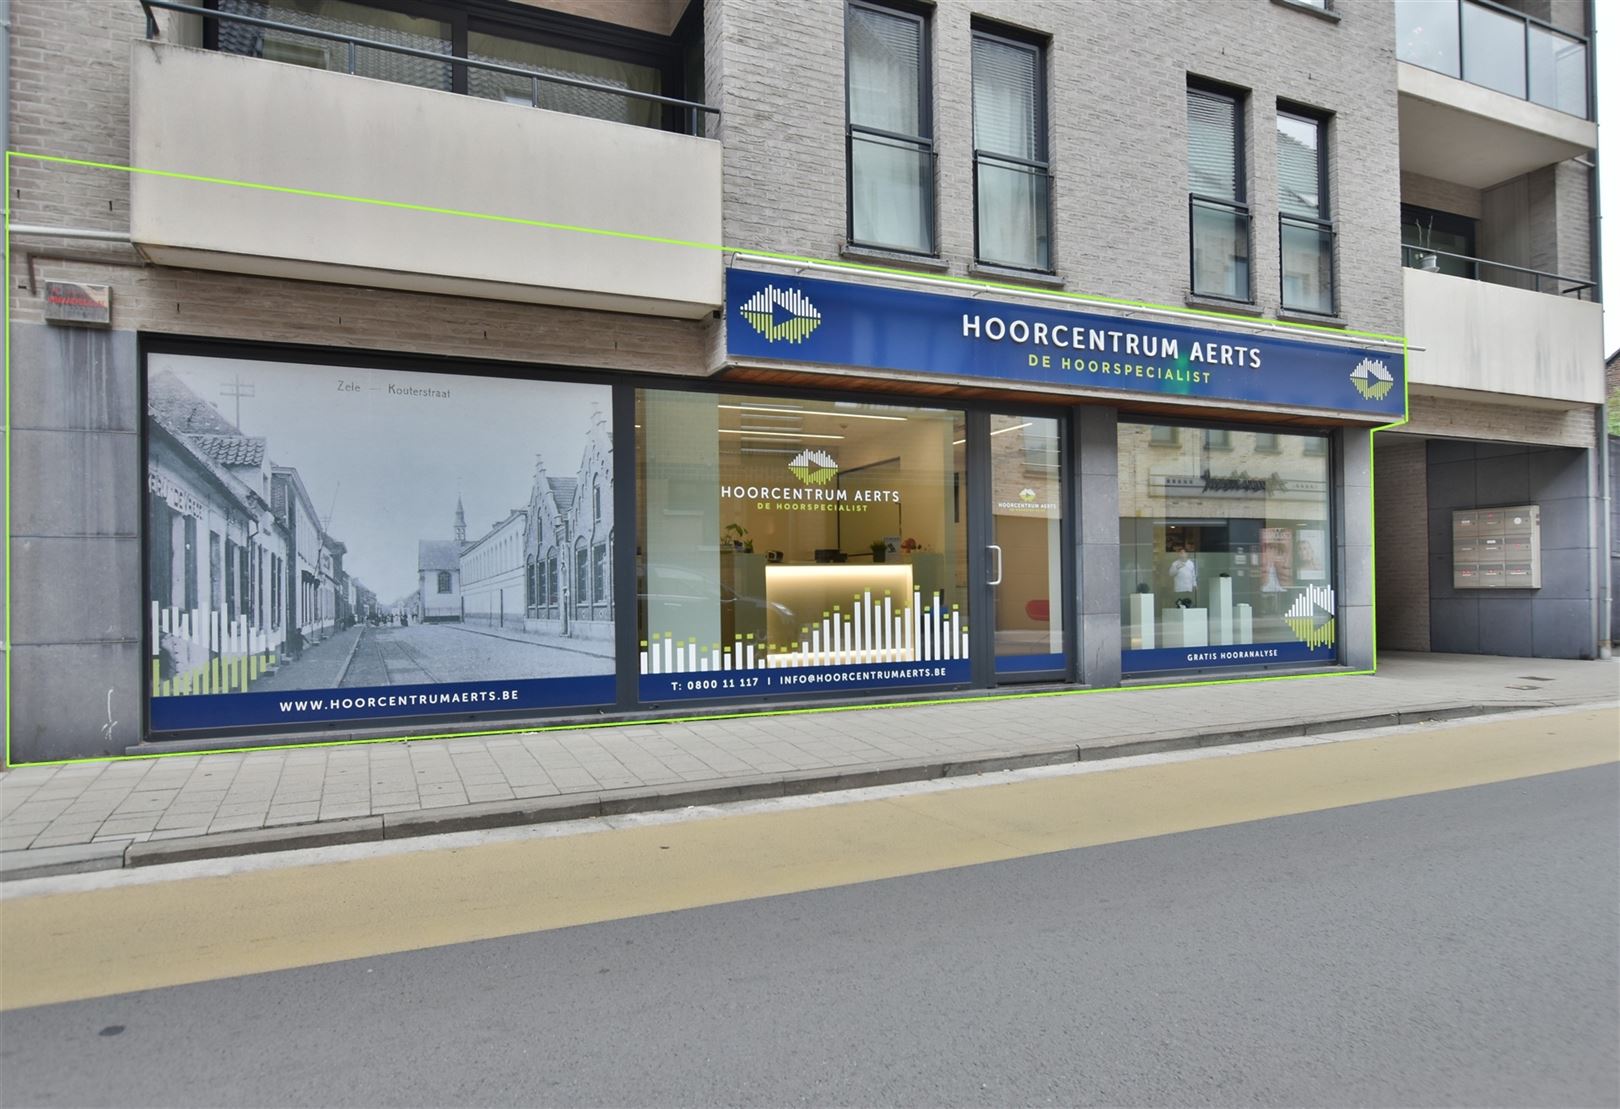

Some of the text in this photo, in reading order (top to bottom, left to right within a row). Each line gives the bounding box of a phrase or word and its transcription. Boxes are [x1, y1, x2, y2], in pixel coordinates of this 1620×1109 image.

[962, 314, 1262, 369] HOORCENTRUM AERTS
[1028, 354, 1211, 384] DE HOORSPECIALIST
[337, 380, 361, 392] Zele
[388, 383, 451, 398] Kouterstraat
[721, 486, 901, 503] HOORCENTRUM AERTS
[757, 502, 868, 512] DE HOORSPECIALIST
[1187, 649, 1278, 661] GRATIS HOORANALYSE
[671, 681, 682, 691] T:
[687, 680, 717, 690] 0800
[722, 678, 735, 688] 11
[739, 677, 759, 687] 117
[780, 667, 947, 685] INFO@HOORCENTRUMAERTS.BE
[279, 690, 519, 712] WWW.HOORCENTRUMAERTS.BE
